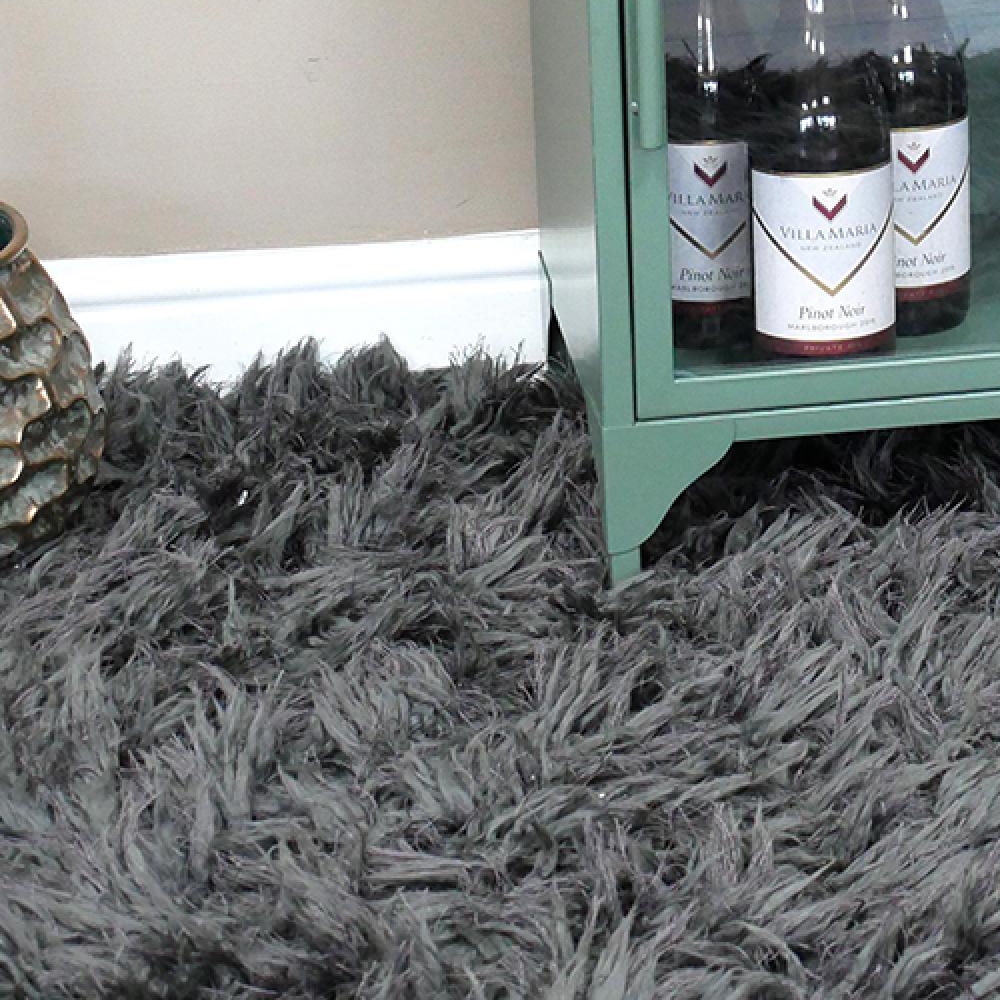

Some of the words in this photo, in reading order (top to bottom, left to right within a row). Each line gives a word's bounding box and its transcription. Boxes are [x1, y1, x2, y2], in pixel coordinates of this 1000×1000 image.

[780, 225, 826, 241] VILLA
[827, 222, 879, 240] MARIA
[921, 250, 947, 266] Noir
[679, 267, 714, 283] Pinot
[799, 304, 835, 321] Pinot
[838, 302, 866, 319] Noir
